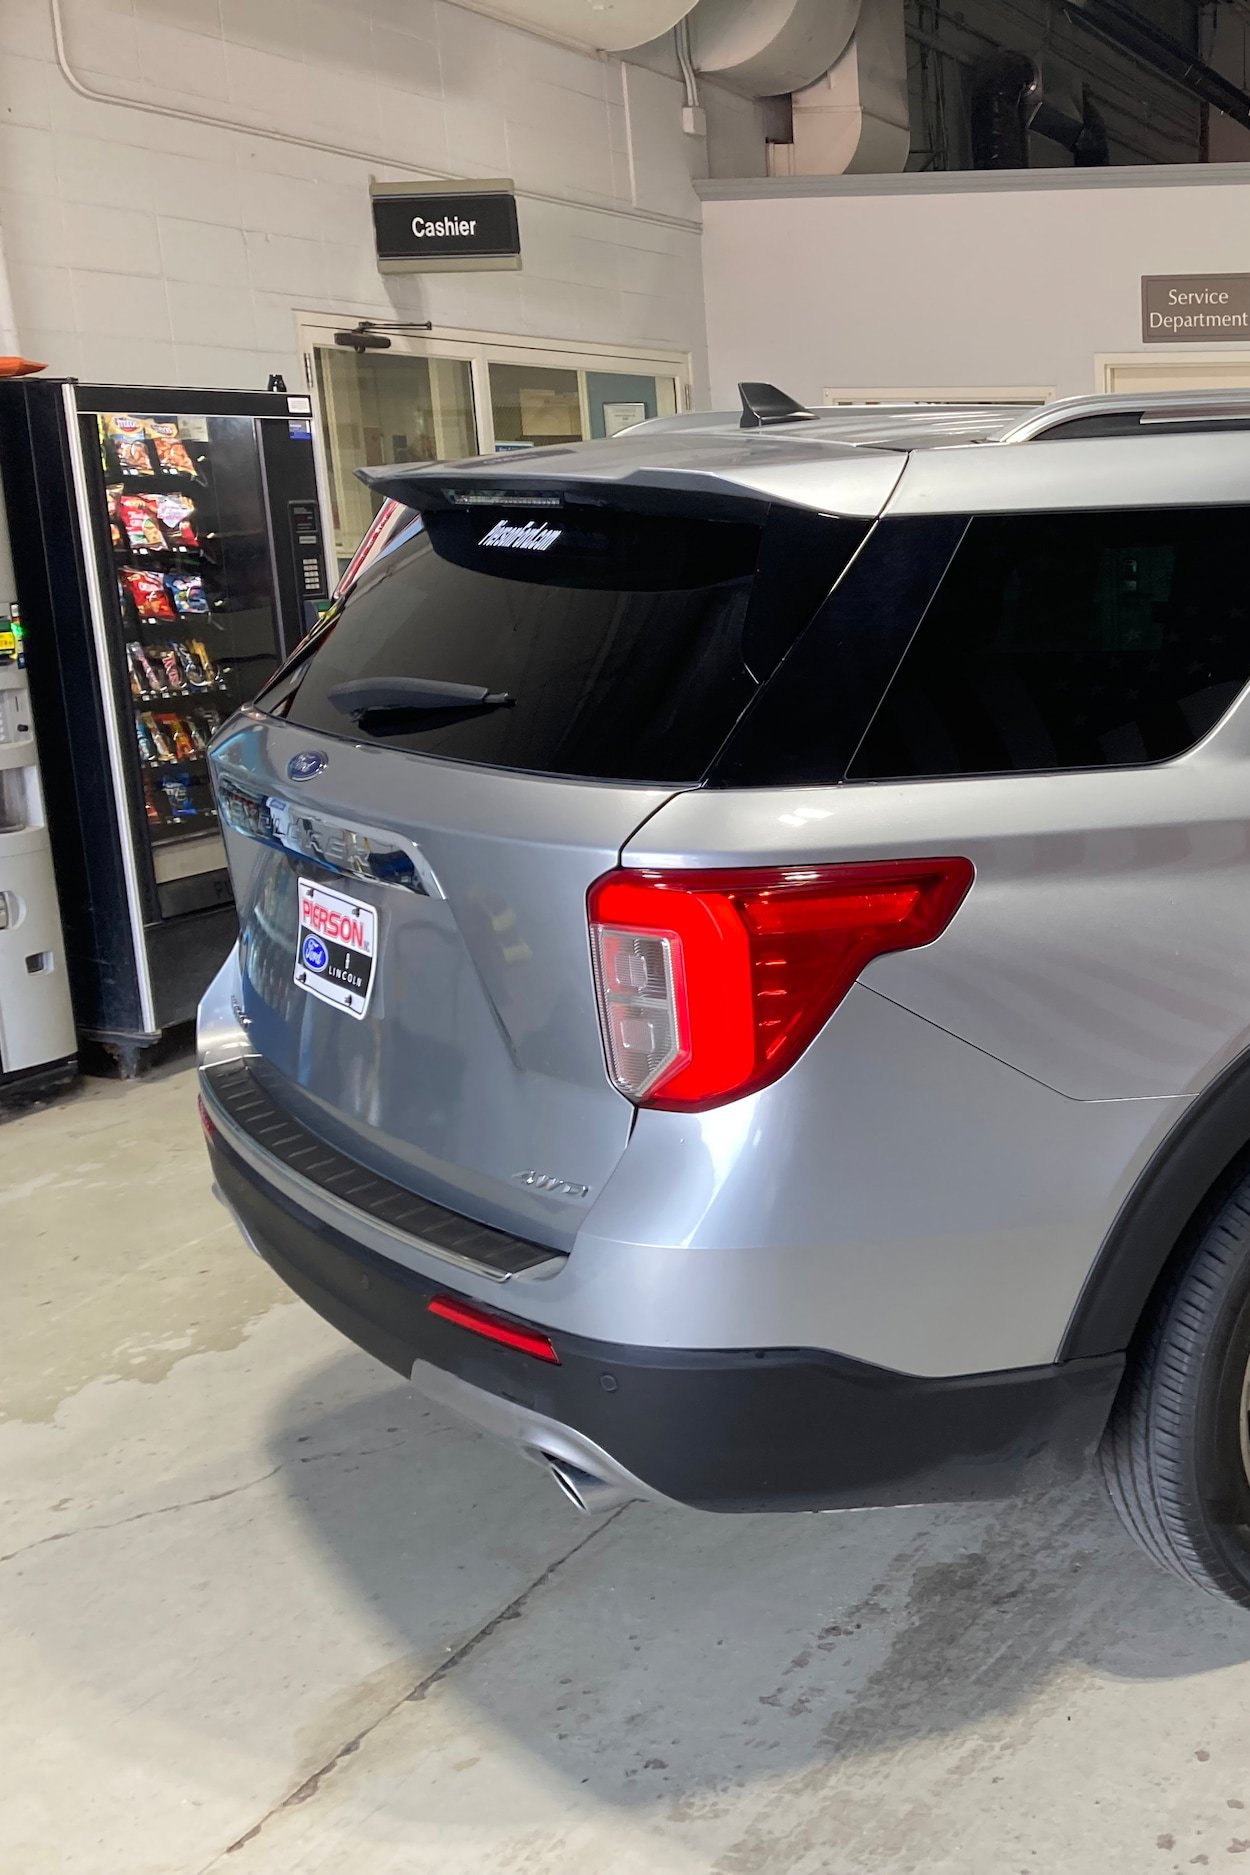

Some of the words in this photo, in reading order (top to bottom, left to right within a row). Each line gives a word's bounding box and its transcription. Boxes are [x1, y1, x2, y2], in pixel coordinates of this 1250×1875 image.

[411, 216, 477, 237] Cashier
[1168, 288, 1229, 305] Service
[1149, 312, 1249, 333] Department
[303, 900, 364, 948] PIERSON
[304, 938, 325, 968] Ford
[328, 965, 362, 987] LINCOLN
[512, 1169, 589, 1198] 4WD
